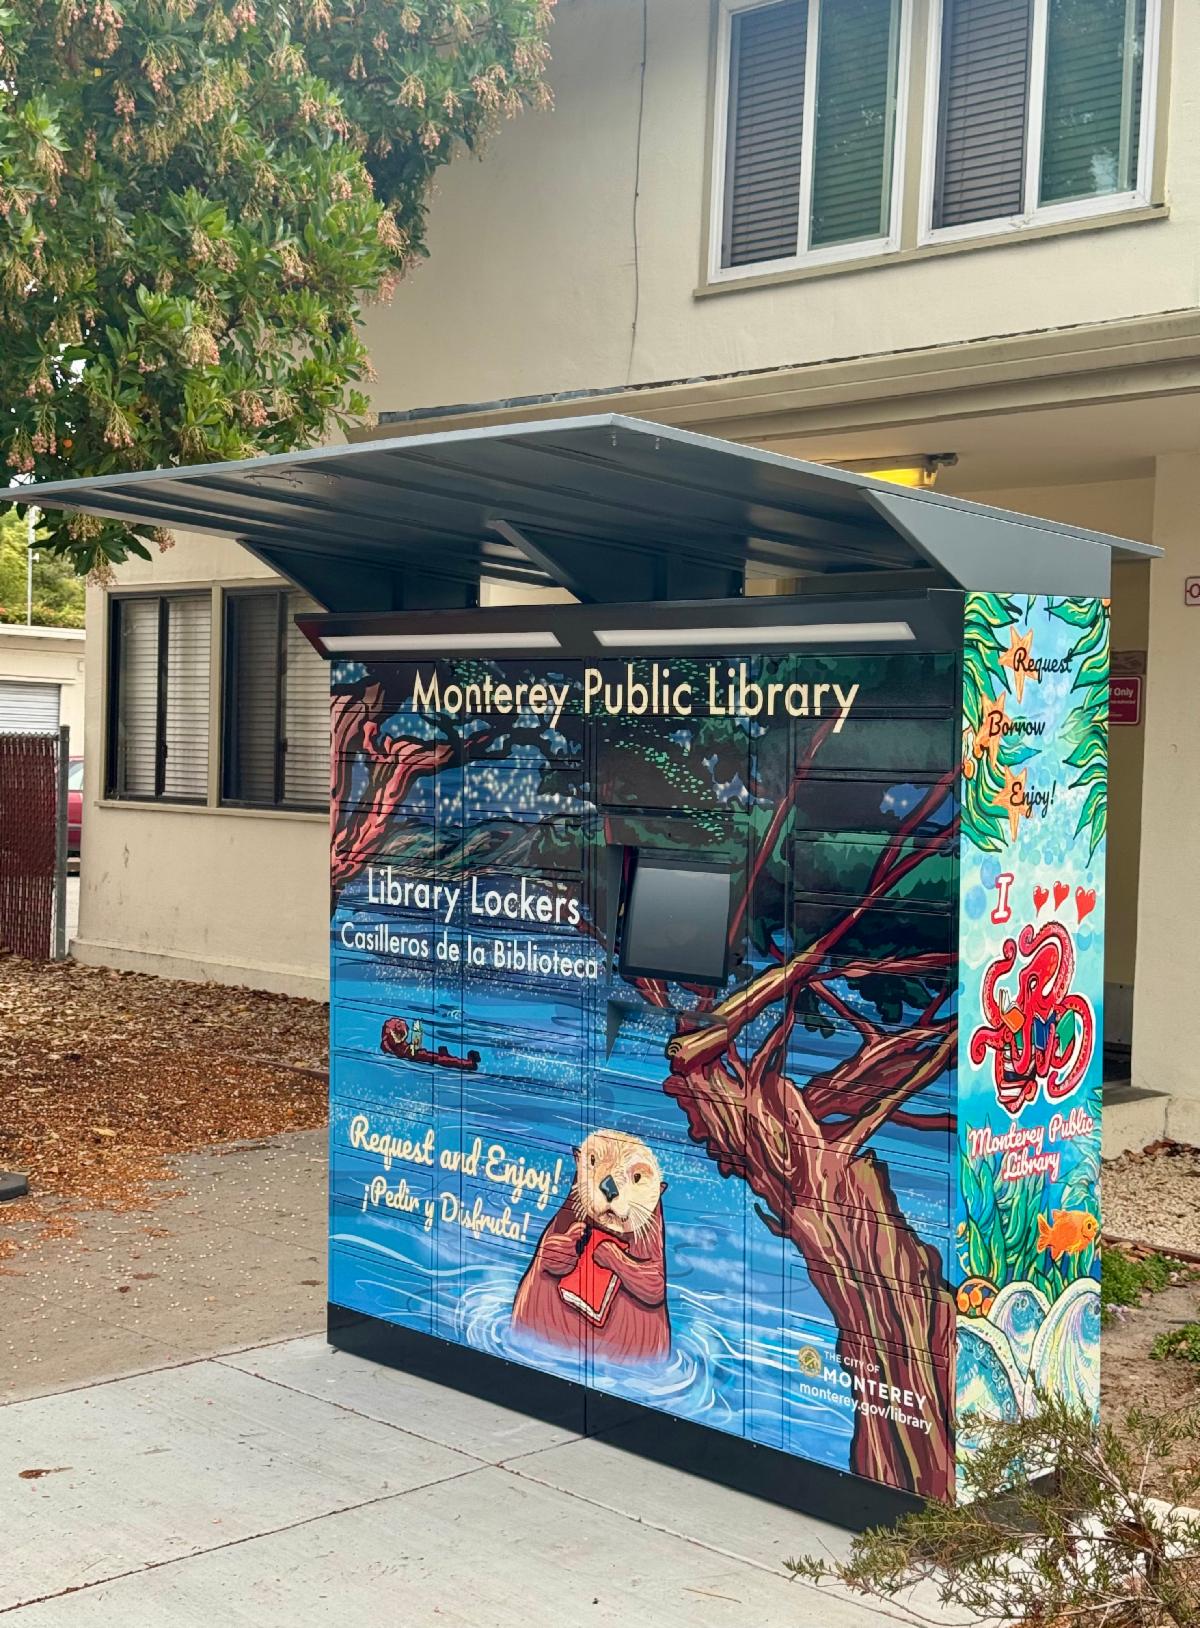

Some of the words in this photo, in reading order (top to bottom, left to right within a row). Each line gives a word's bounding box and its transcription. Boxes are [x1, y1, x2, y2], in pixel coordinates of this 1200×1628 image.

[1013, 646, 1072, 684] Request
[412, 668, 569, 729] Monterey
[584, 663, 692, 716] Public
[709, 662, 860, 734] Library
[1113, 687, 1134, 698] Only
[988, 709, 1046, 738] Borrow
[1009, 780, 1057, 818] Enjoy!
[367, 865, 461, 923] Library
[471, 876, 582, 925] Lockers
[991, 872, 1014, 925] I
[340, 921, 429, 958] Casilleros
[436, 931, 460, 962] de
[467, 935, 485, 966] la
[493, 939, 598, 979] Biblioteca
[968, 1121, 1045, 1159] Monterey
[1049, 1106, 1094, 1143] Public
[350, 1114, 435, 1171] Request
[440, 1136, 482, 1177] and
[485, 1144, 563, 1211] Enjoy!
[1002, 1144, 1061, 1183] Library
[361, 1175, 420, 1213] ¡Pedir
[424, 1199, 435, 1232] y
[440, 1191, 531, 1242] Disfruta!
[823, 1350, 842, 1363] THE
[844, 1356, 865, 1371] CITY
[866, 1362, 881, 1374] OF
[823, 1366, 927, 1411] MONTEREY
[799, 1382, 933, 1435] monterey.gov/library
